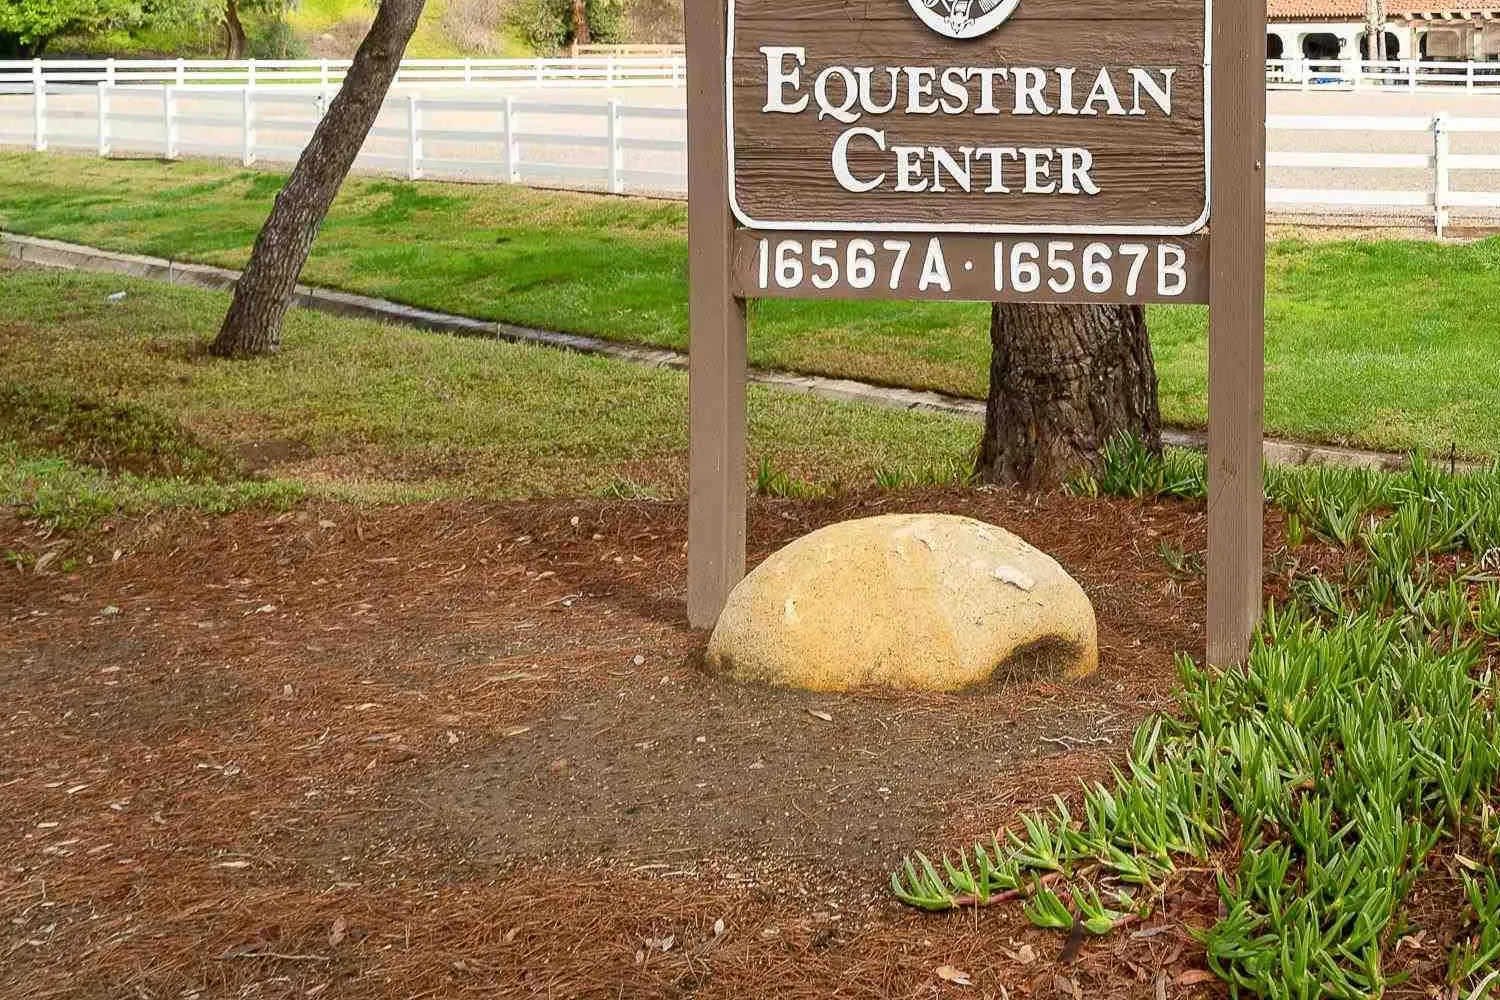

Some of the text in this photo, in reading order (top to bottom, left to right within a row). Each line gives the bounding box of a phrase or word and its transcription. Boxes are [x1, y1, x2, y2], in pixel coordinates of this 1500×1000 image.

[759, 46, 1177, 124] EQUESTRIAN
[831, 127, 1102, 196] CENTER
[758, 237, 1188, 297] 16567A 16567B
